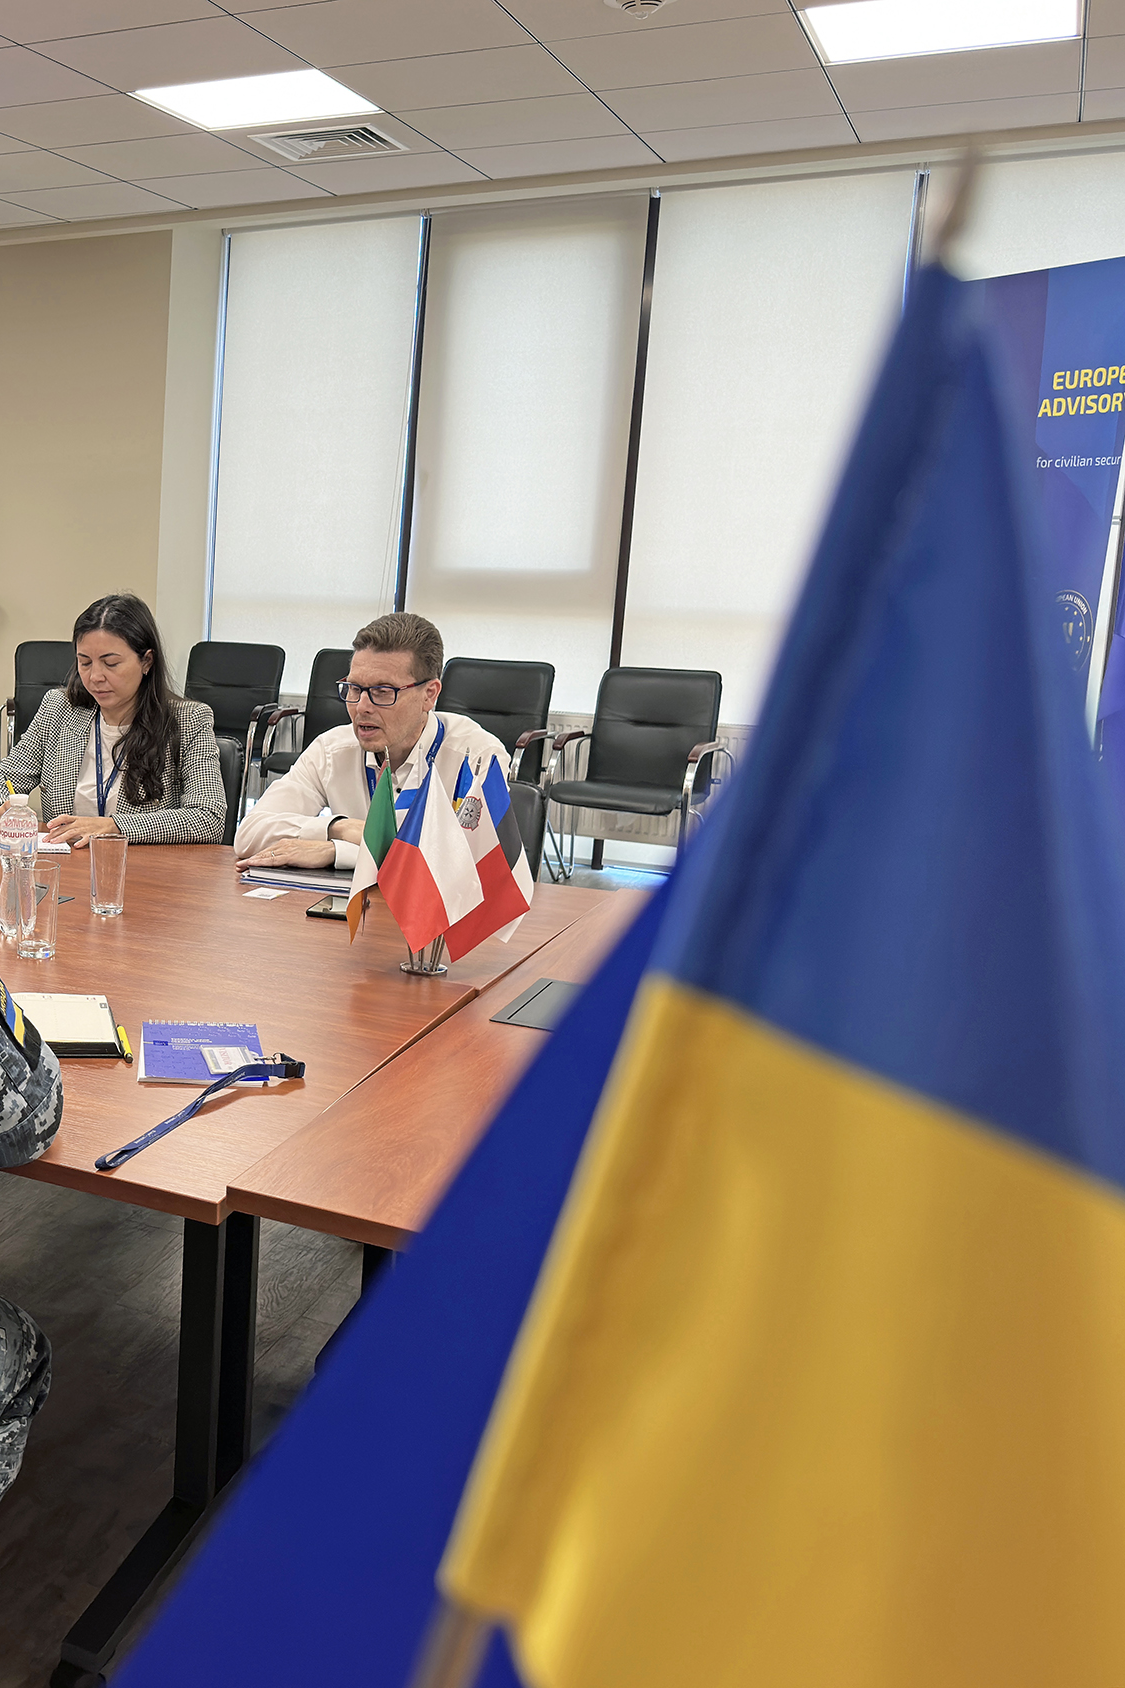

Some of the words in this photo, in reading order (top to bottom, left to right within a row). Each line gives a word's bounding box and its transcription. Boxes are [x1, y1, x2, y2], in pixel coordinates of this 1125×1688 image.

[1052, 365, 1125, 390] EUROPE
[1037, 392, 1125, 418] ADVISOR
[1036, 456, 1053, 468] for
[1055, 455, 1093, 468] civilian
[1094, 455, 1121, 466] secur
